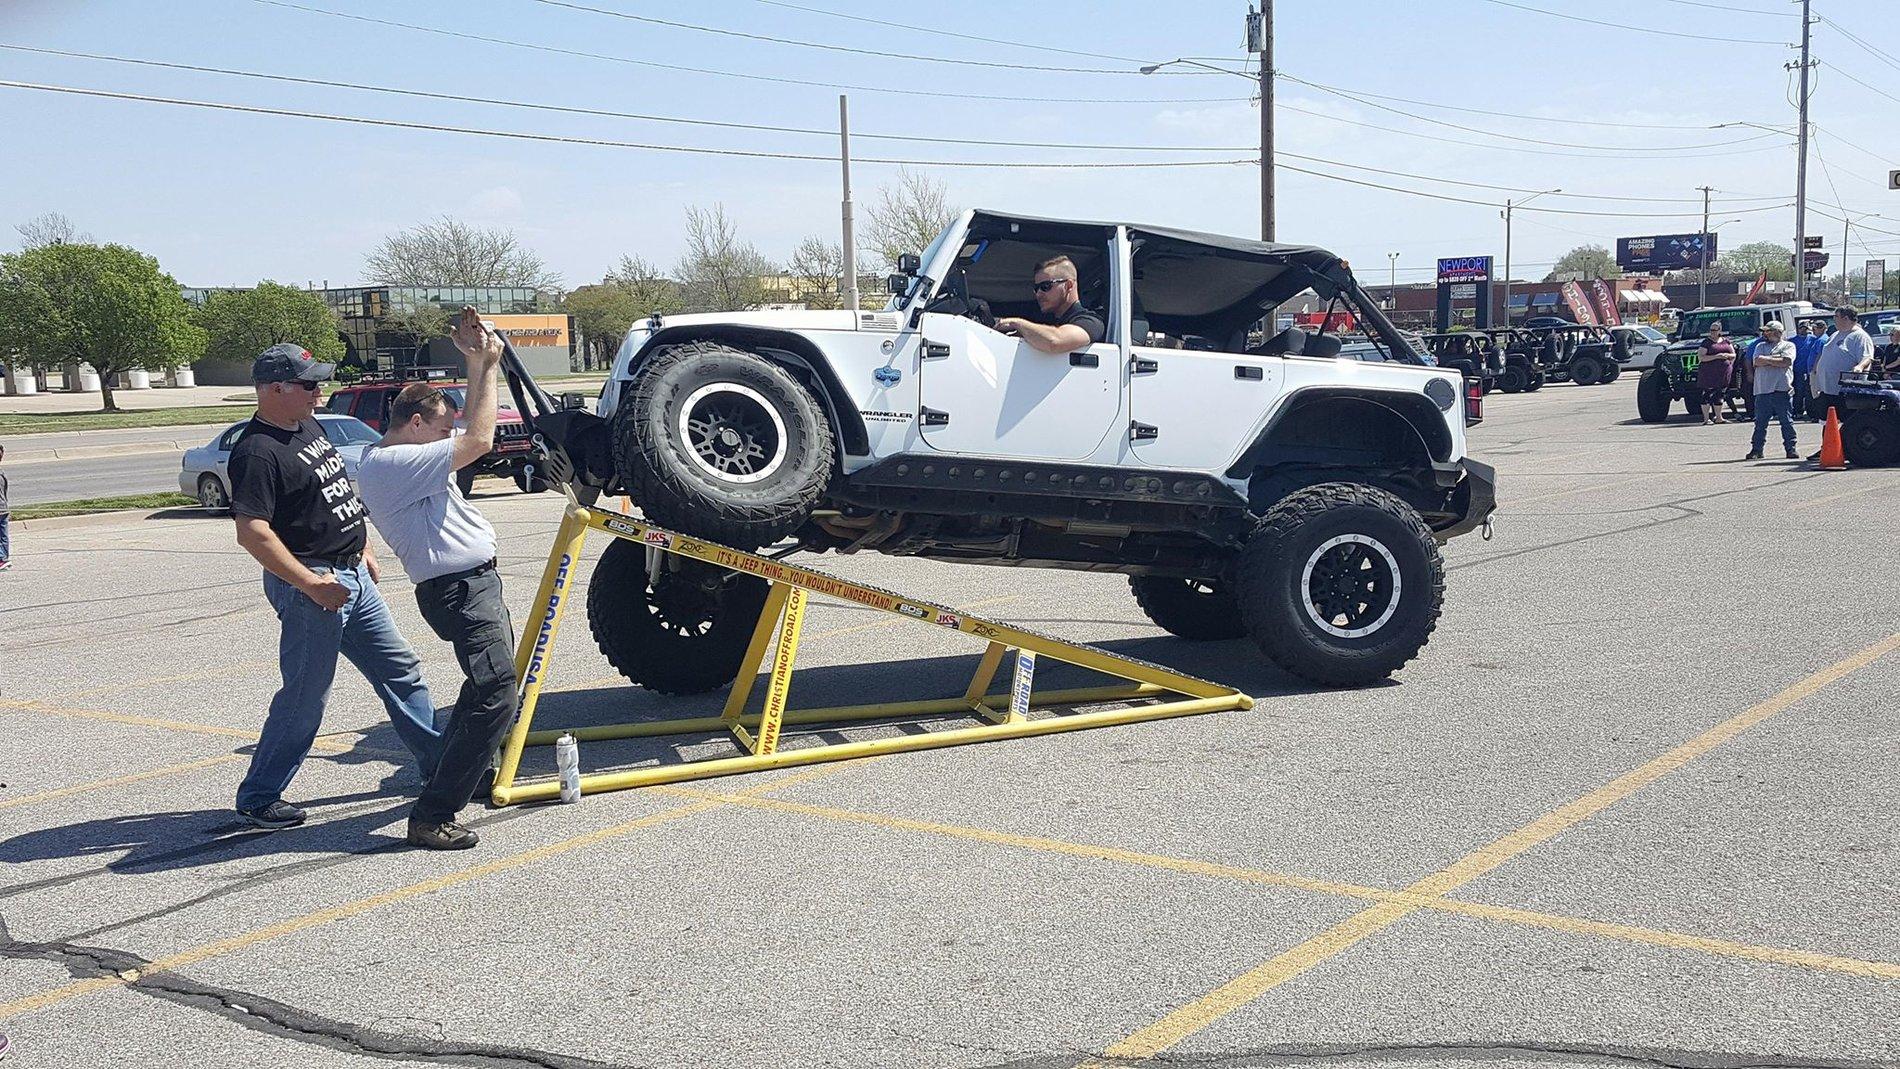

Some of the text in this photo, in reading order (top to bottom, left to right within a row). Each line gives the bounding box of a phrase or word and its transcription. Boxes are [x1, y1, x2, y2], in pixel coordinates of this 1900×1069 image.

[1438, 257, 1487, 273] NEWPORT
[860, 410, 913, 419] WRANGLER
[297, 436, 332, 465] I WAS
[314, 452, 345, 483] MADE
[321, 477, 351, 503] FOR
[645, 532, 667, 542] JKS
[716, 550, 731, 563] IT'S
[732, 555, 739, 565] A
[739, 557, 759, 571] JEEP
[806, 577, 842, 596] WOULDN'T
[843, 584, 893, 607] UNDERSTAND!
[936, 614, 956, 624] JKS
